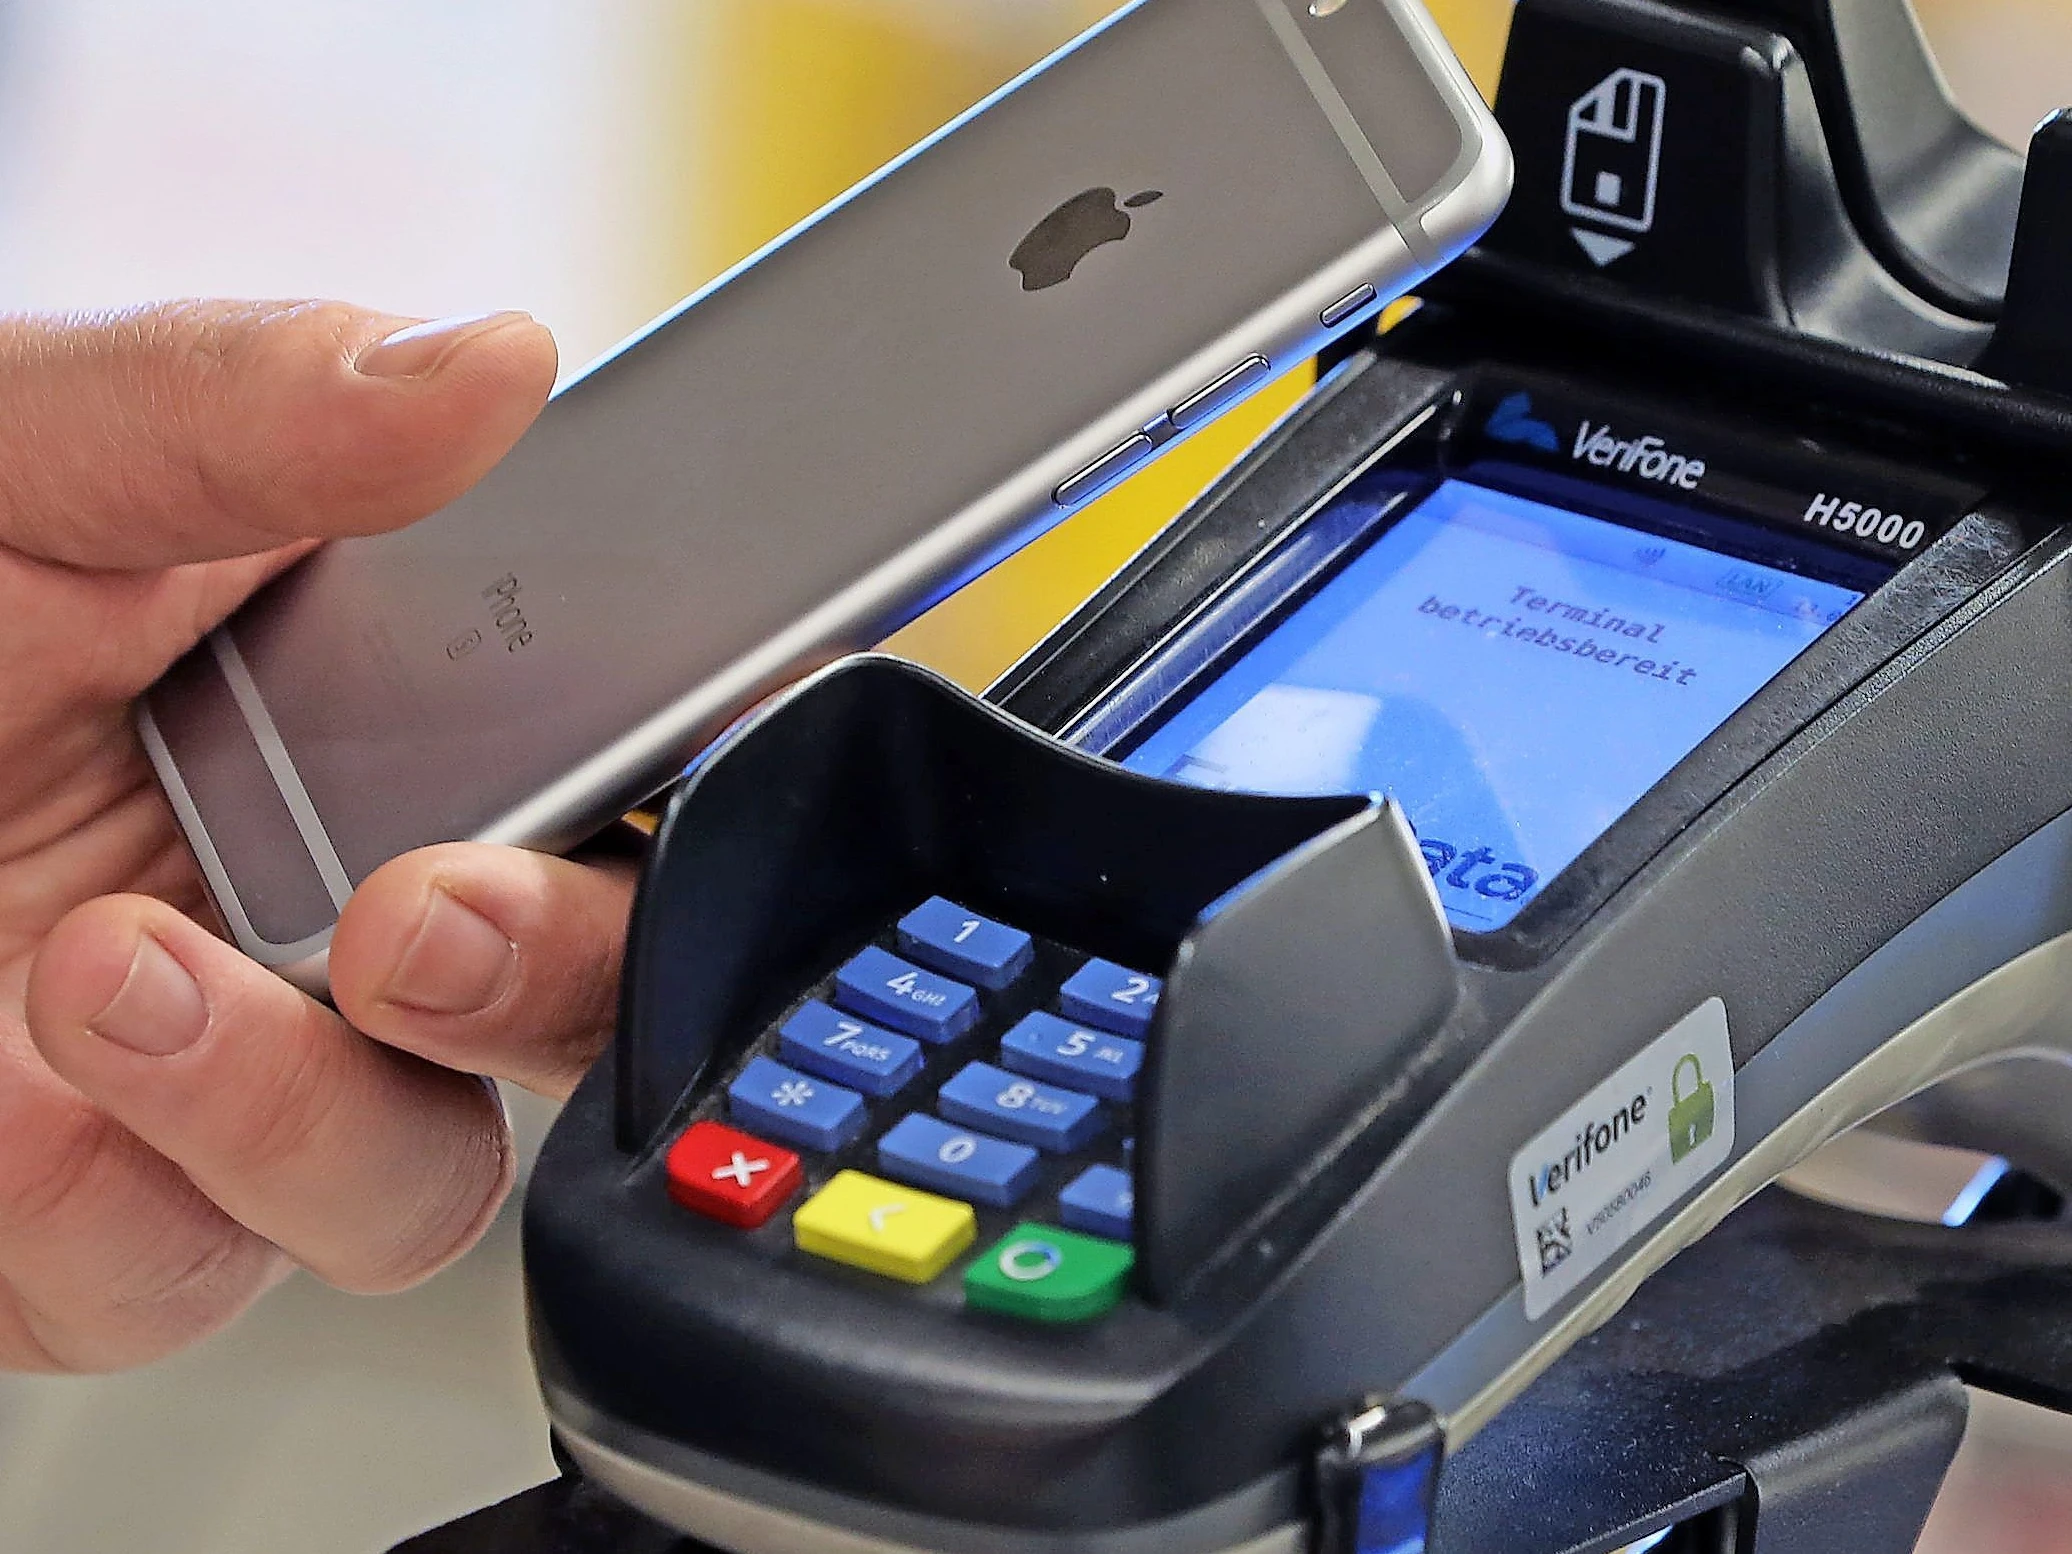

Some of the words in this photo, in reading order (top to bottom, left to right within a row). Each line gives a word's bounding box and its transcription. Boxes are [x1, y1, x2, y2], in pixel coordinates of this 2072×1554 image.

[1571, 420, 1706, 491] VeriFone
[1802, 493, 1926, 551] H5000
[1509, 584, 1666, 645] Terminal
[1416, 596, 1699, 688] betriebsbereit
[952, 918, 980, 944] 1
[885, 970, 919, 996] 4
[1109, 976, 1151, 1005] 2
[822, 1020, 863, 1048] 7
[1055, 1030, 1098, 1057] 5
[995, 1082, 1036, 1109] 8
[936, 1135, 978, 1165] 0
[1528, 1094, 1648, 1207] Verifone
